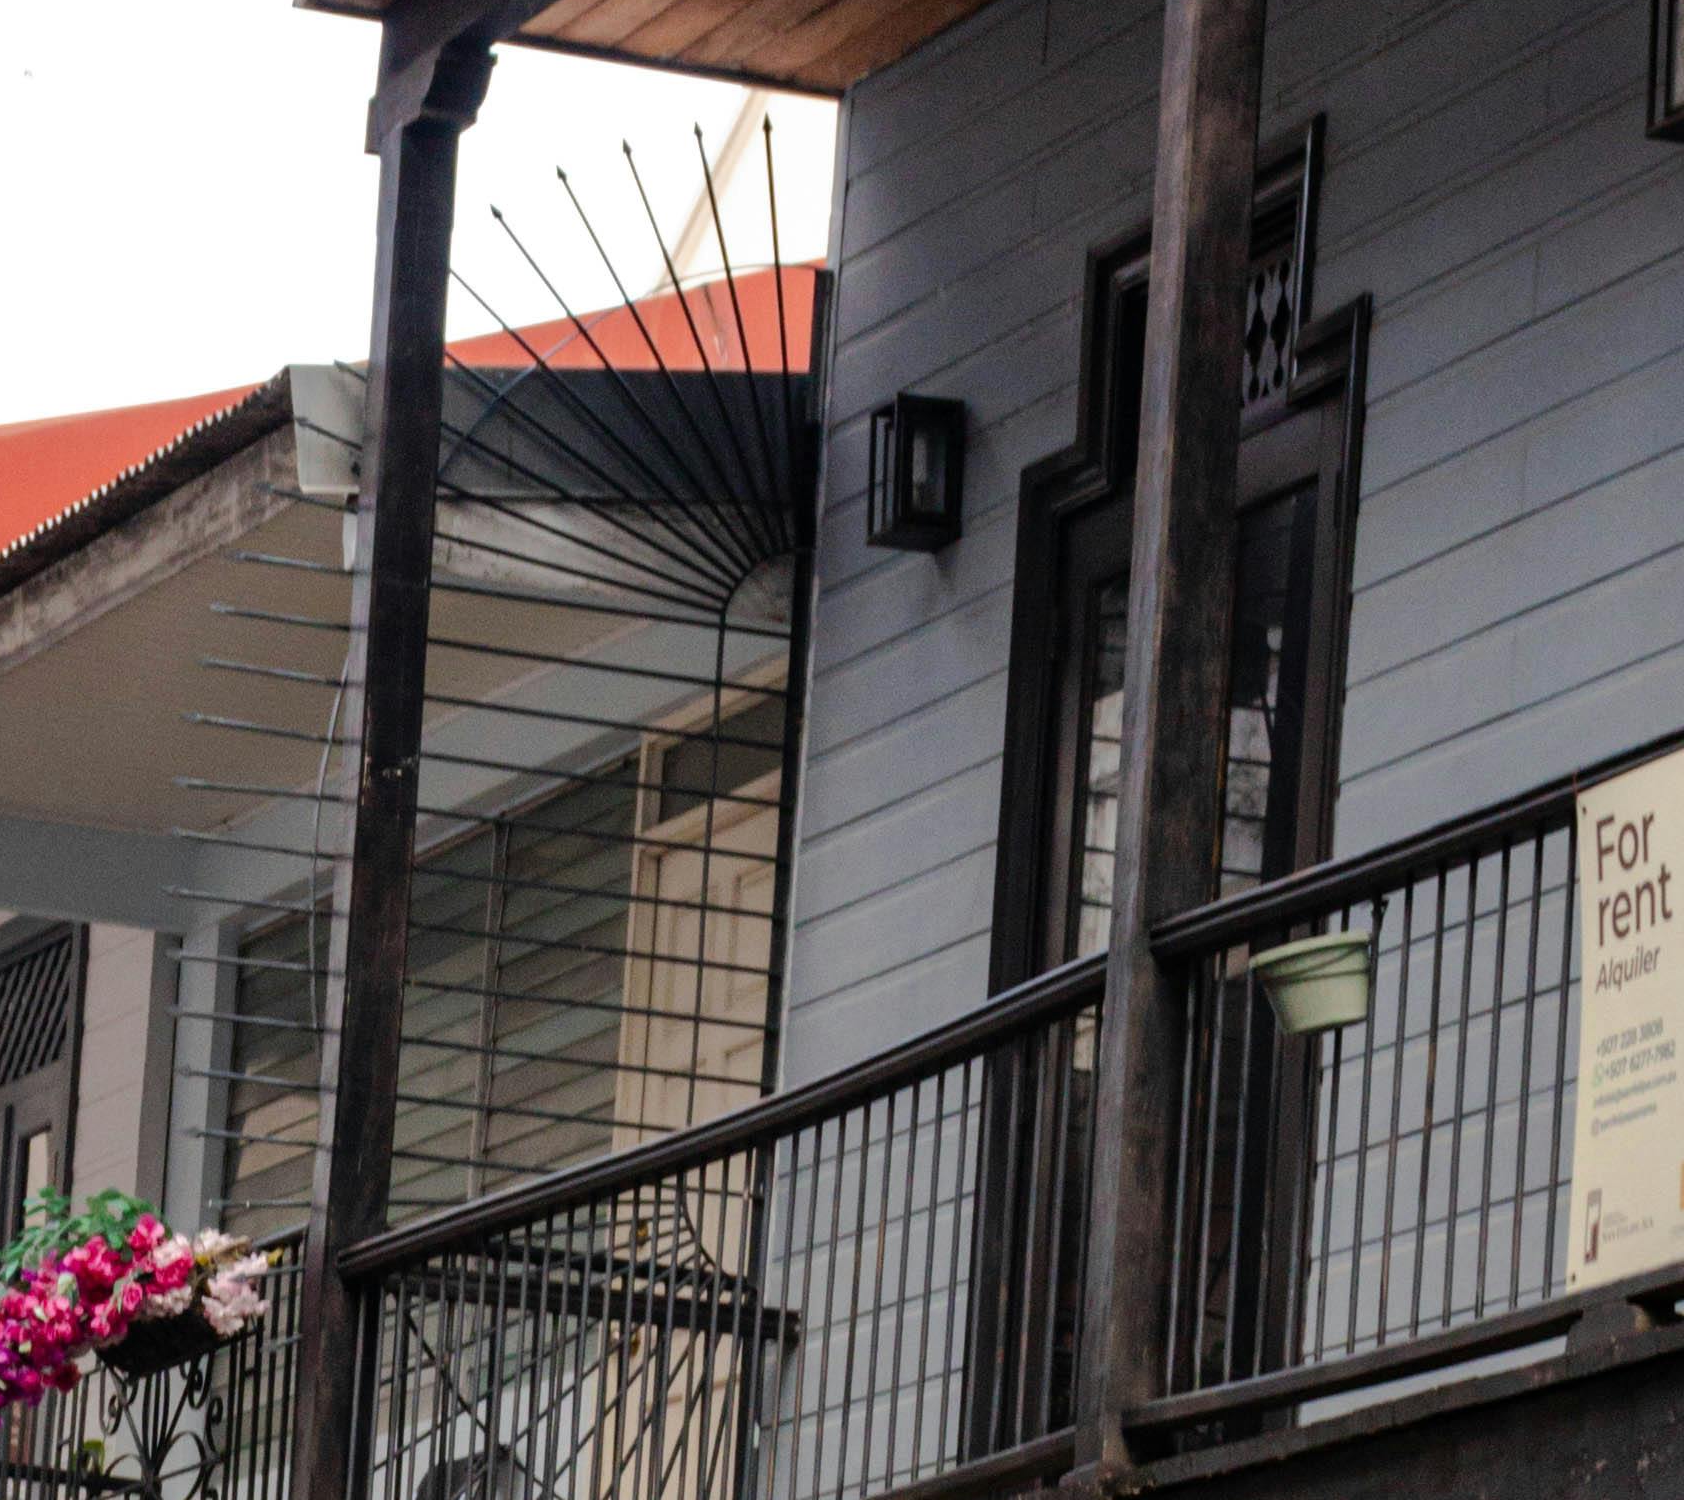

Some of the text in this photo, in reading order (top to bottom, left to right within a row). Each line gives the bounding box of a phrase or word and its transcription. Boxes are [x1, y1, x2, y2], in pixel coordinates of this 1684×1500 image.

[1596, 813, 1654, 881] For
[1598, 865, 1672, 946] rent
[1596, 946, 1659, 992] Alquiler
